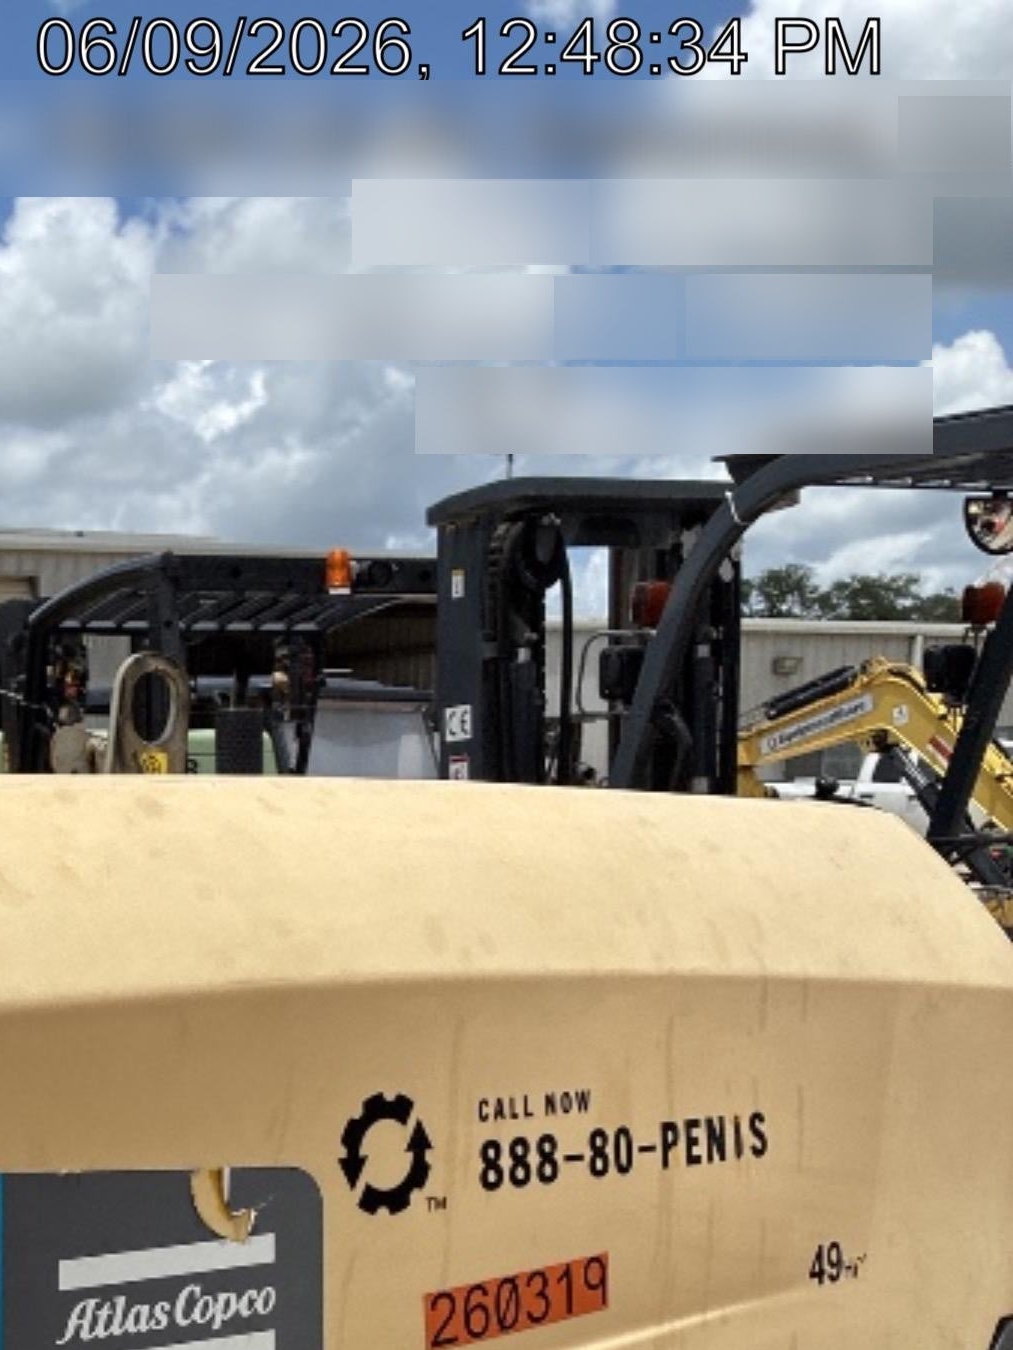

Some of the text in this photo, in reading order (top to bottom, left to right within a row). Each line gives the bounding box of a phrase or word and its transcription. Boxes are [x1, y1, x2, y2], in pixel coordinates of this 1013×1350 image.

[478, 1089, 591, 1122] CALL NOW
[479, 1112, 768, 1191] 888-80-PENIS
[55, 1284, 276, 1345] Atlas Copco
[430, 1256, 607, 1347] 260319
